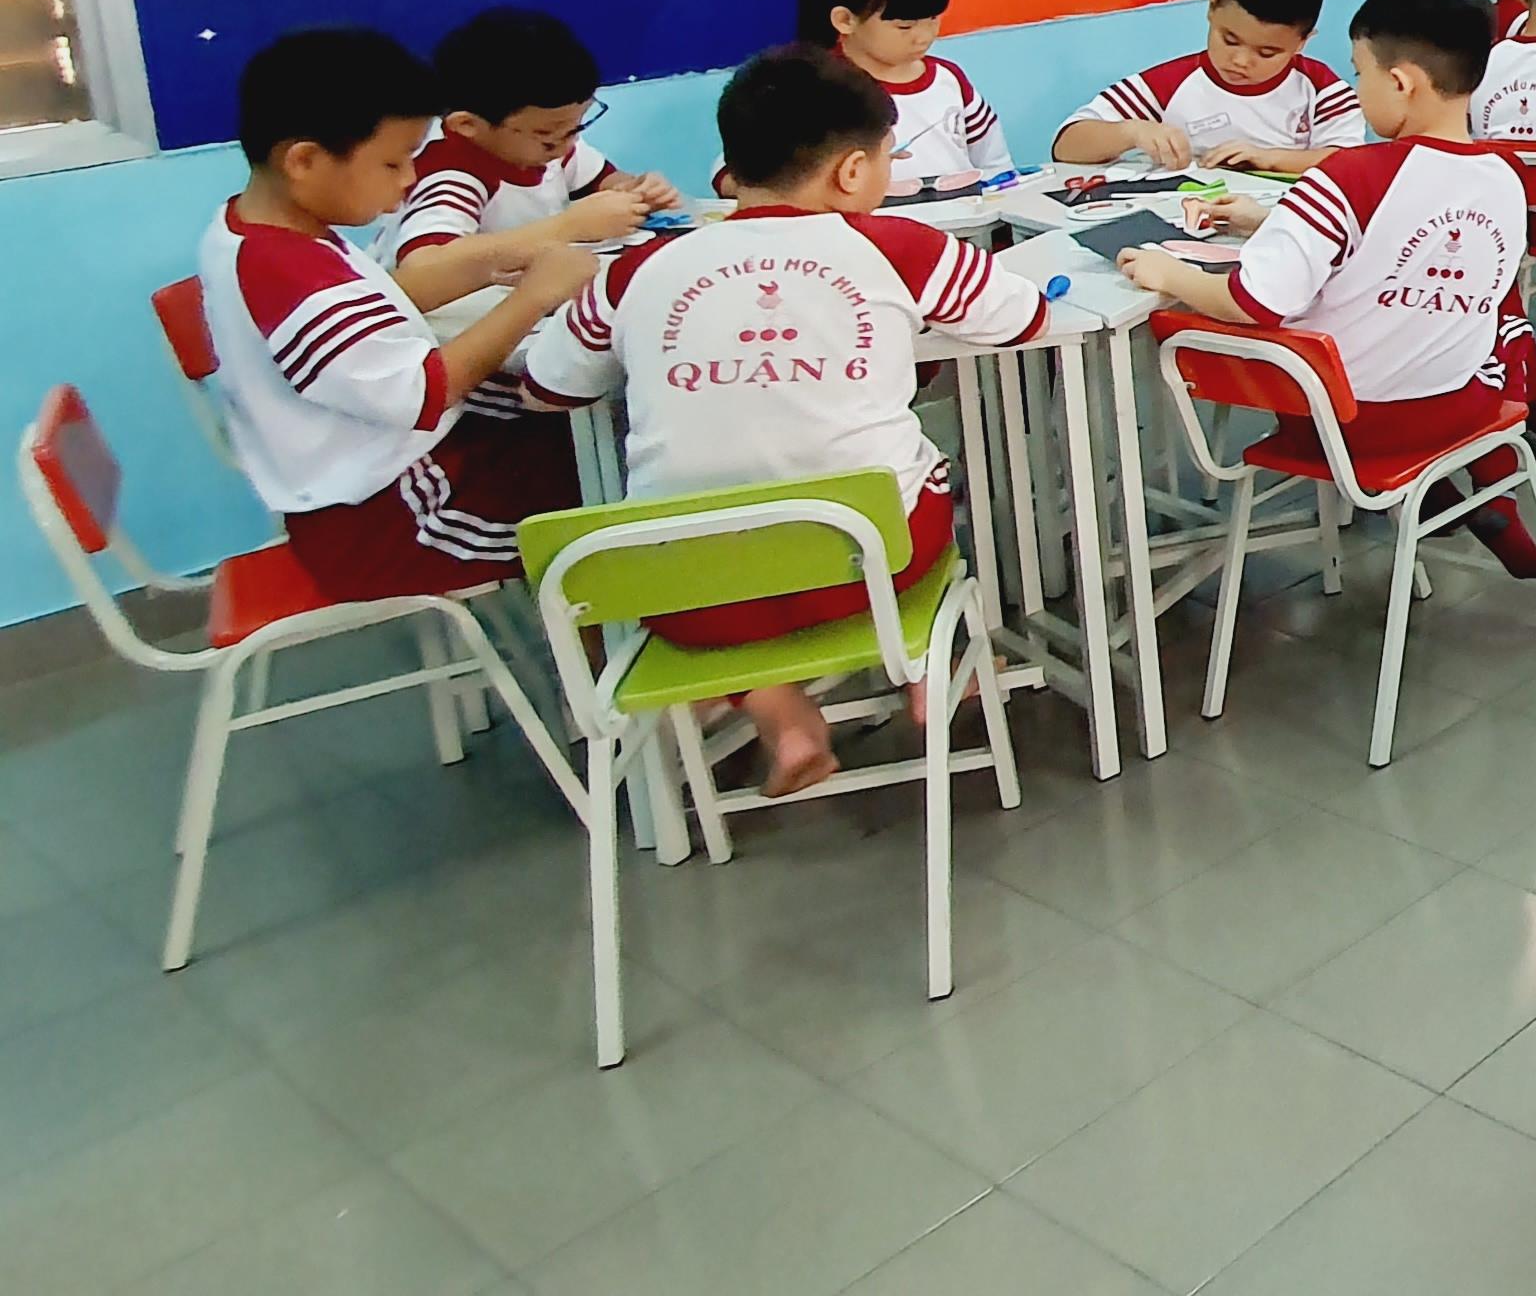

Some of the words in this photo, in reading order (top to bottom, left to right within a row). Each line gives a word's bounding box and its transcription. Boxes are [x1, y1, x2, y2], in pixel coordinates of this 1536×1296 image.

[830, 276, 867, 307] HIM
[855, 311, 875, 349] LAM
[1377, 286, 1476, 315] QUẬN
[1477, 296, 1493, 315] 6
[667, 352, 827, 392] QUẬN
[845, 356, 869, 381] 6
